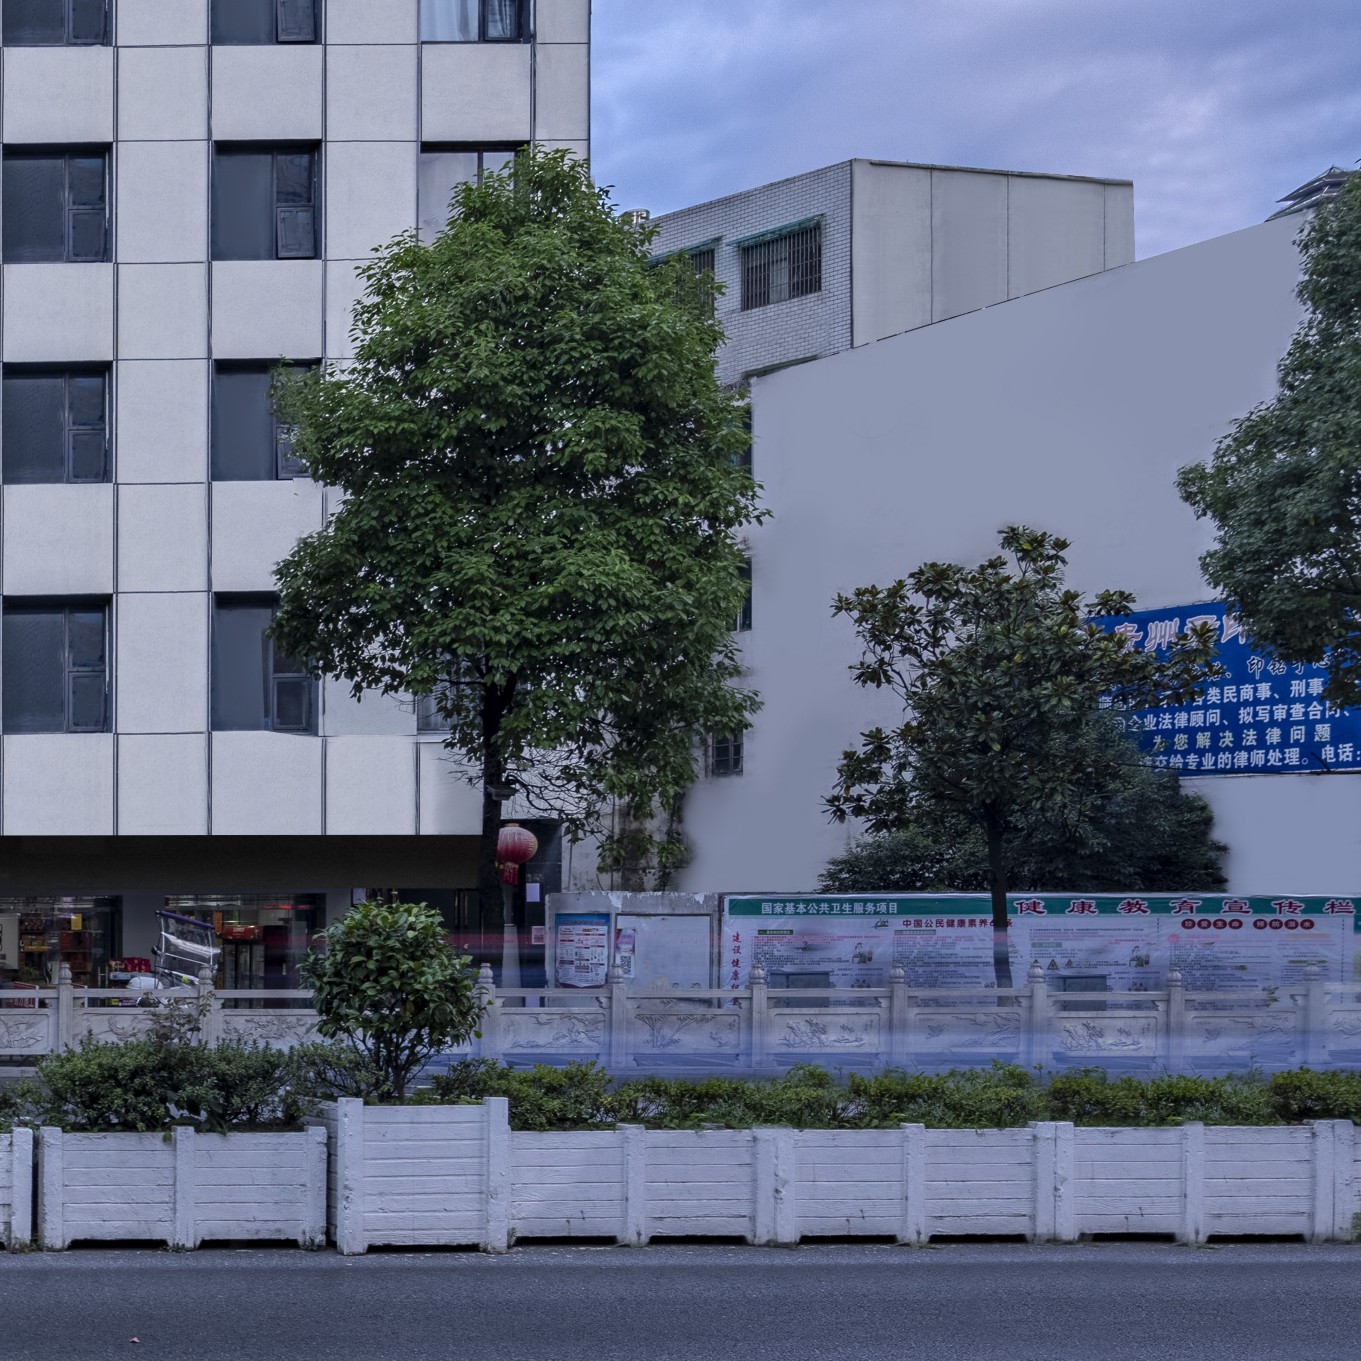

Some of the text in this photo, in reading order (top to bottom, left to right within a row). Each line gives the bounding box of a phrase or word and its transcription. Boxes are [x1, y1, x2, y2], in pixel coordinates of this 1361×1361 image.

[1151, 723, 1332, 754] 为您解决法律问题
[761, 902, 898, 914] 国家基本公共卫生服务项目
[1014, 899, 1355, 915] 健康教育宣传栏
[902, 918, 1013, 928] 中国公民健康素养6条
